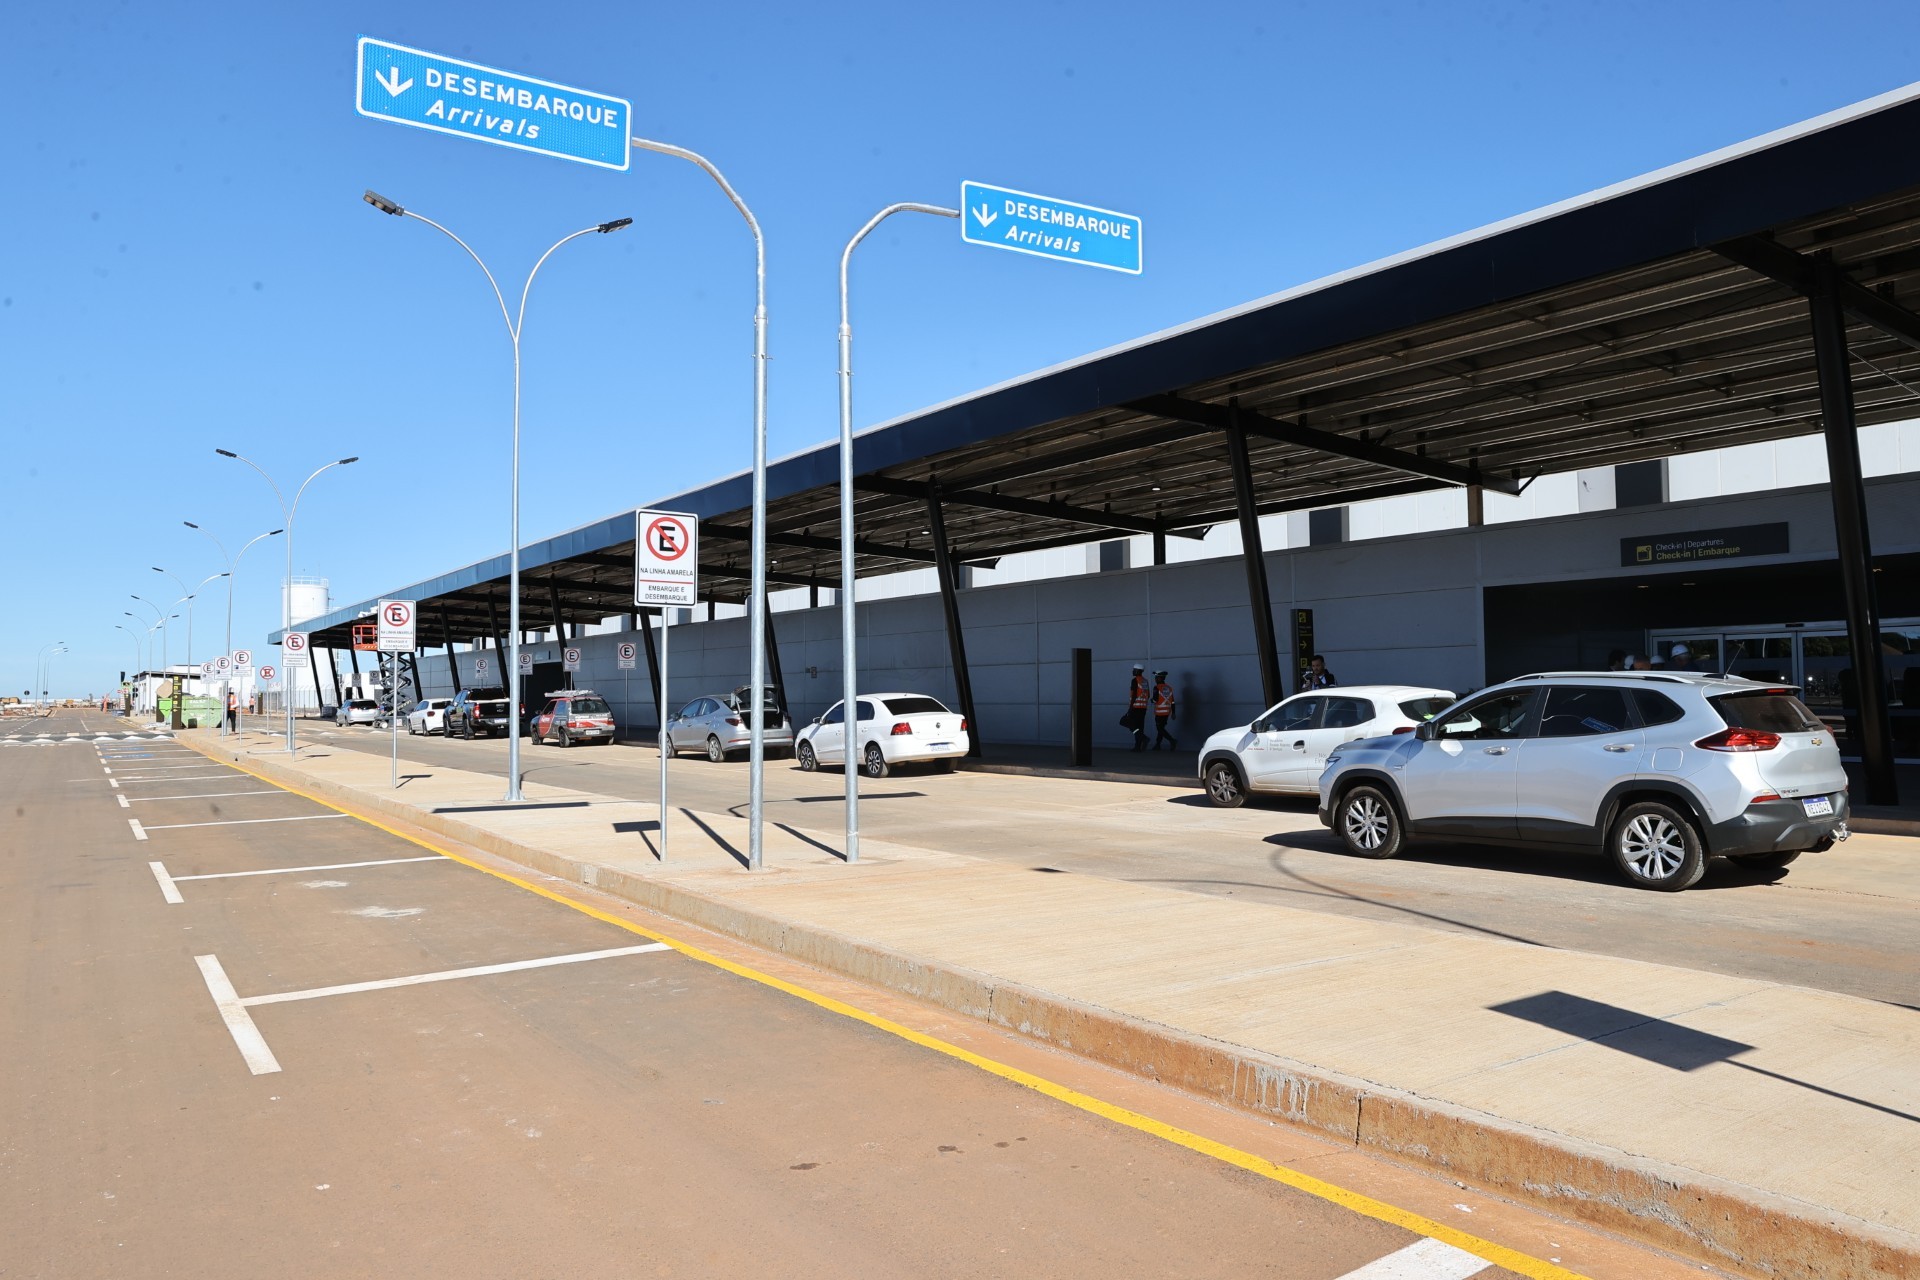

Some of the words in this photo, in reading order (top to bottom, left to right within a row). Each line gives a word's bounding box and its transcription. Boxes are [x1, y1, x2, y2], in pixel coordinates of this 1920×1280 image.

[425, 67, 618, 129] DESEMBARQUE
[424, 99, 541, 139] Arrivals
[1005, 200, 1131, 240] DESEMBARQUE
[1004, 225, 1081, 253] Arrivals
[659, 525, 676, 552] E
[1655, 543, 1682, 551] Check-in
[1687, 539, 1724, 548] Departures
[1656, 550, 1691, 560] Check-in
[1698, 546, 1740, 557] Embarque
[644, 593, 688, 601] DESEMBARQUE
[648, 584, 680, 592] EMBARQUE
[624, 647, 630, 656] E
